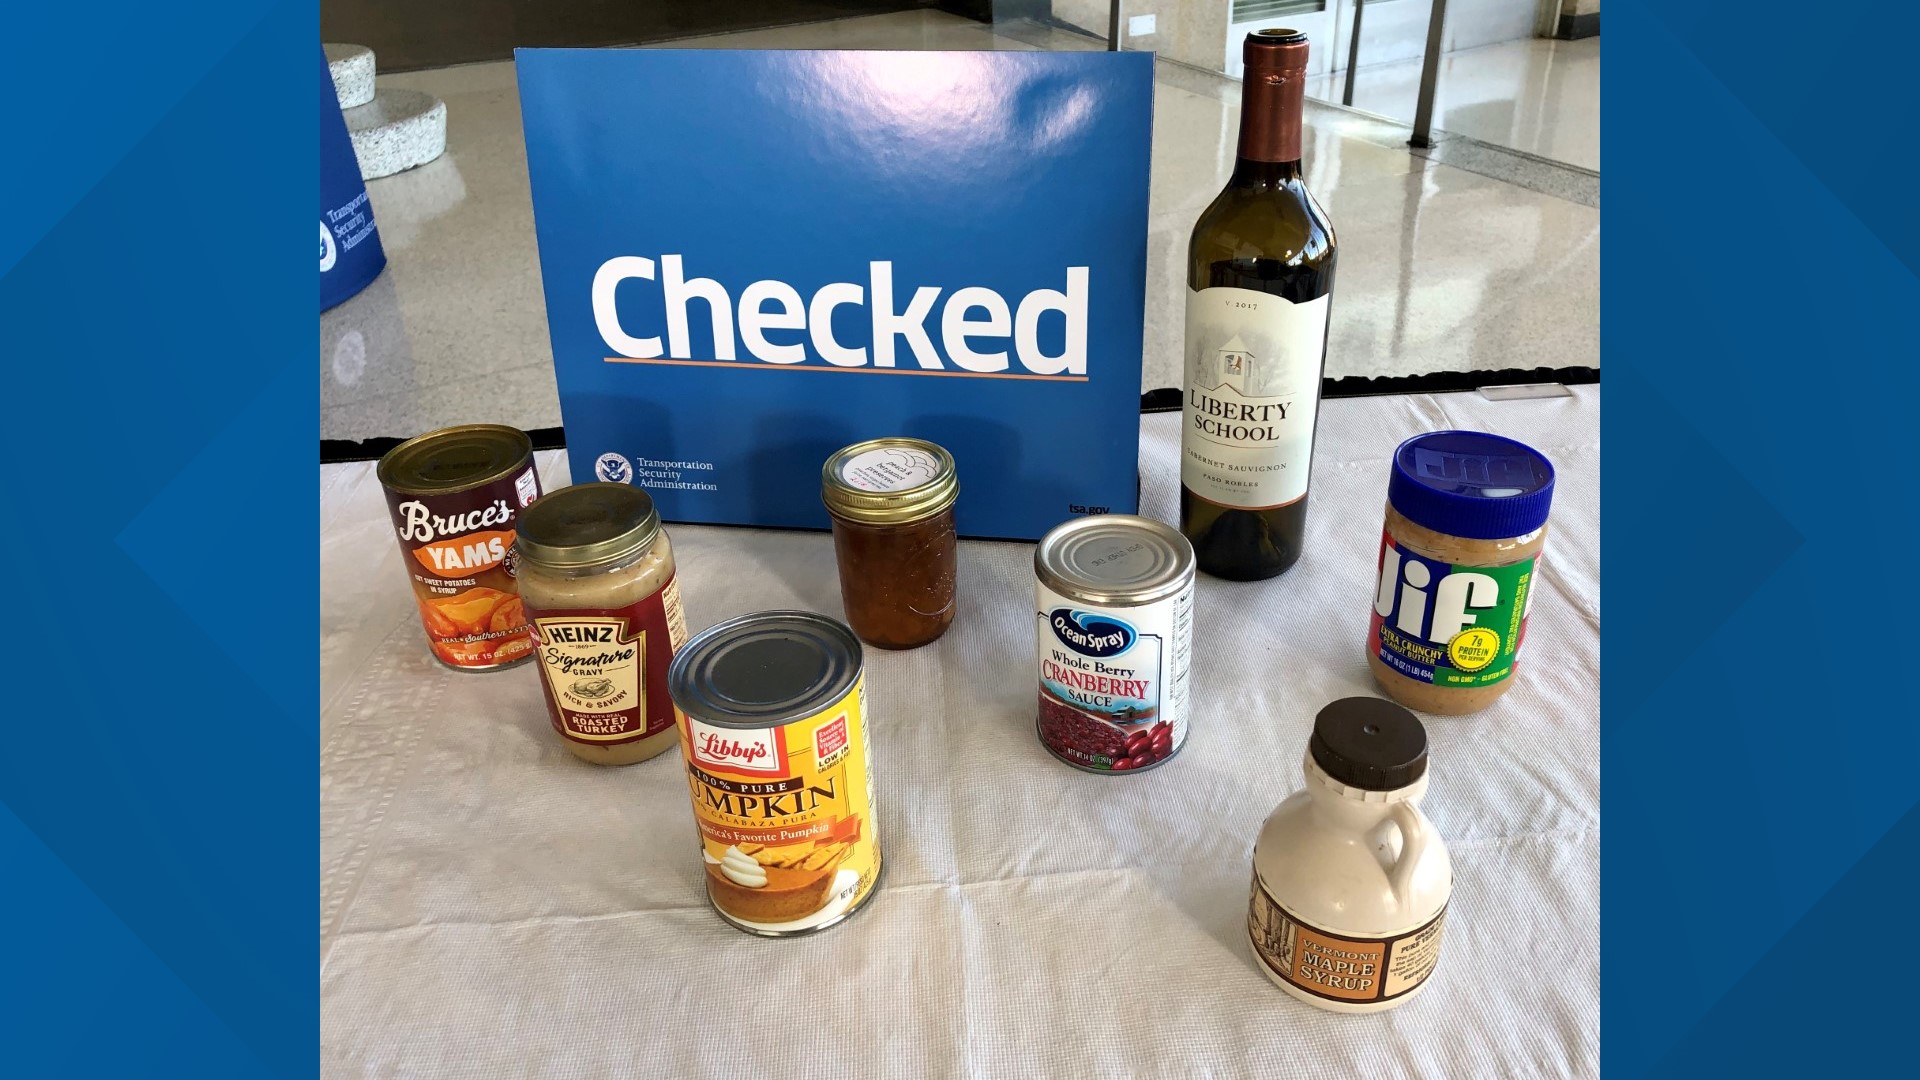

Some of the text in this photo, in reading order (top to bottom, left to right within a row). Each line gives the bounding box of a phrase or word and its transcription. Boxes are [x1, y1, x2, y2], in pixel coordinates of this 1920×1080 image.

[334, 211, 366, 238] Security
[591, 254, 1090, 375] Checked
[1236, 302, 1258, 311] 2017
[1190, 388, 1292, 422] LIBERTY
[1194, 414, 1280, 441] SCHOOL
[637, 457, 714, 470] Transportation
[1187, 447, 1287, 473] CABERNET SAUVIGNON
[639, 468, 682, 480] Security
[640, 478, 718, 491] Administration
[1203, 473, 1259, 488] PASO ROBLES
[1069, 503, 1111, 516] tsa.gov
[399, 500, 515, 542] Bruce's
[425, 537, 506, 570] YAMS
[424, 577, 443, 587] SWEET
[444, 578, 476, 587] POTATOES
[1373, 541, 1499, 645] Jif
[464, 630, 506, 644] Southern
[548, 626, 614, 643] HEINZ
[1054, 616, 1125, 652] Ocean Spray
[1380, 624, 1443, 660] EXTRA CRUNCHY
[1472, 635, 1483, 647] 7g
[545, 647, 636, 674] Signature
[1383, 635, 1436, 665] PEANUT BUTTER
[1458, 646, 1489, 657] PROTEIN
[573, 668, 603, 676] GRAVY
[1052, 649, 1135, 679] Whole Berry
[1043, 659, 1150, 700] CRANBERRY
[563, 691, 582, 706] RICH
[596, 690, 628, 709] SAVORY
[1068, 689, 1113, 707] SAUCE
[572, 716, 628, 727] ROASTED
[577, 723, 625, 734] TURKEY
[698, 731, 767, 763] Libby's
[819, 744, 849, 767] LOW IN
[696, 769, 788, 793] 100% PURE
[689, 776, 836, 818] UMPKIN
[711, 811, 816, 826] CALABAZA PURA
[734, 832, 777, 842] Favorite
[780, 823, 829, 840] Pumpkin
[1303, 939, 1379, 960] VERMONT
[1401, 941, 1420, 953] PURE
[1303, 950, 1375, 976] MAPLE
[1300, 965, 1373, 991] SYRUP
